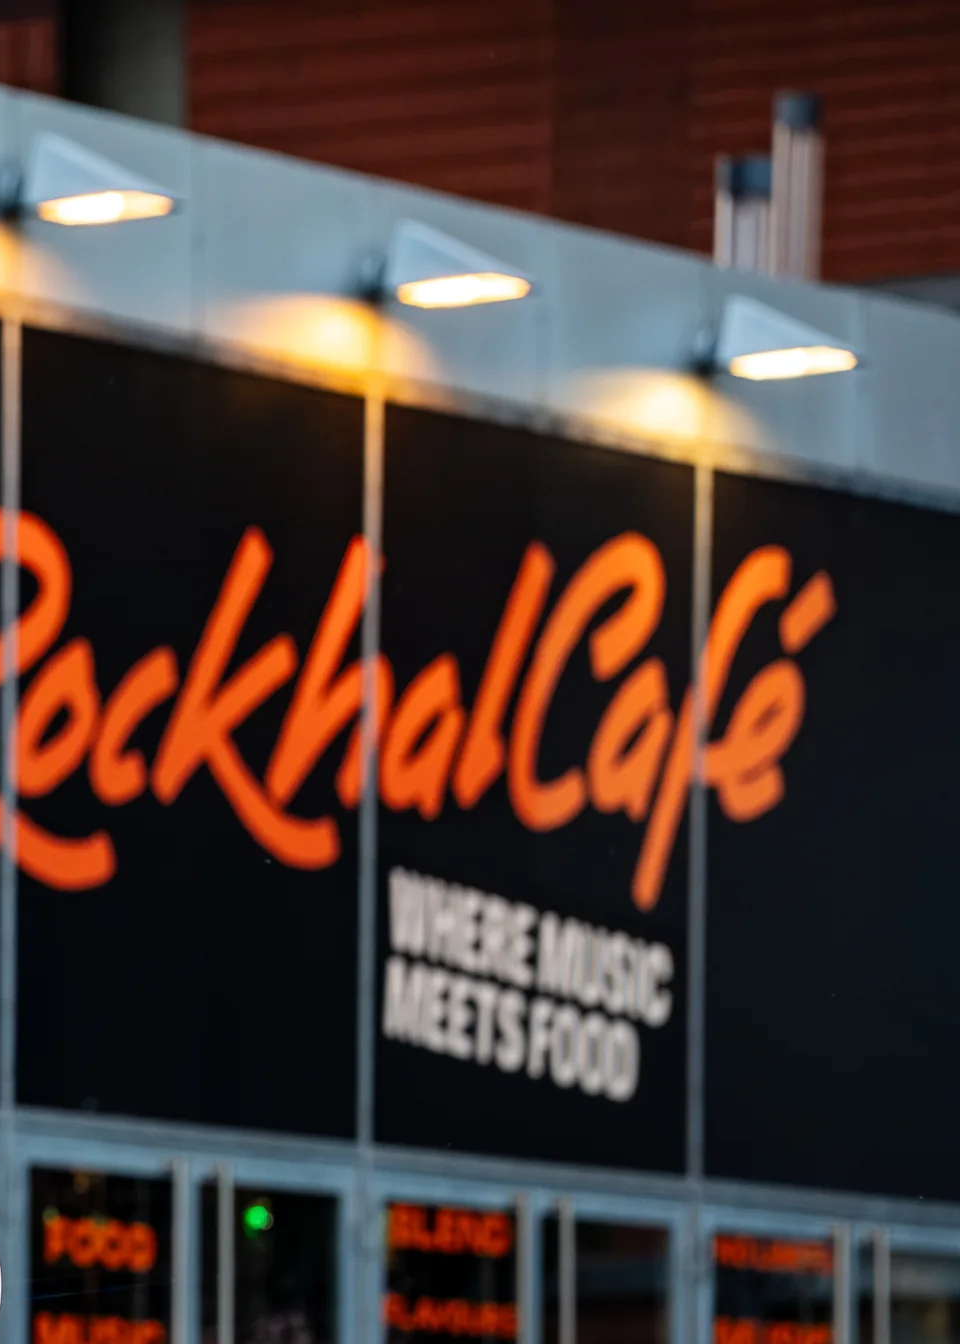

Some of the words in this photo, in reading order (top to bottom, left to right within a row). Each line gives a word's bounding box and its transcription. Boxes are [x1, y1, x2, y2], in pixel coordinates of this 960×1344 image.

[388, 865, 537, 989] WHERE
[538, 909, 674, 1029] MUSIC
[382, 953, 526, 1073] MEETS
[526, 996, 640, 1103] FOOD
